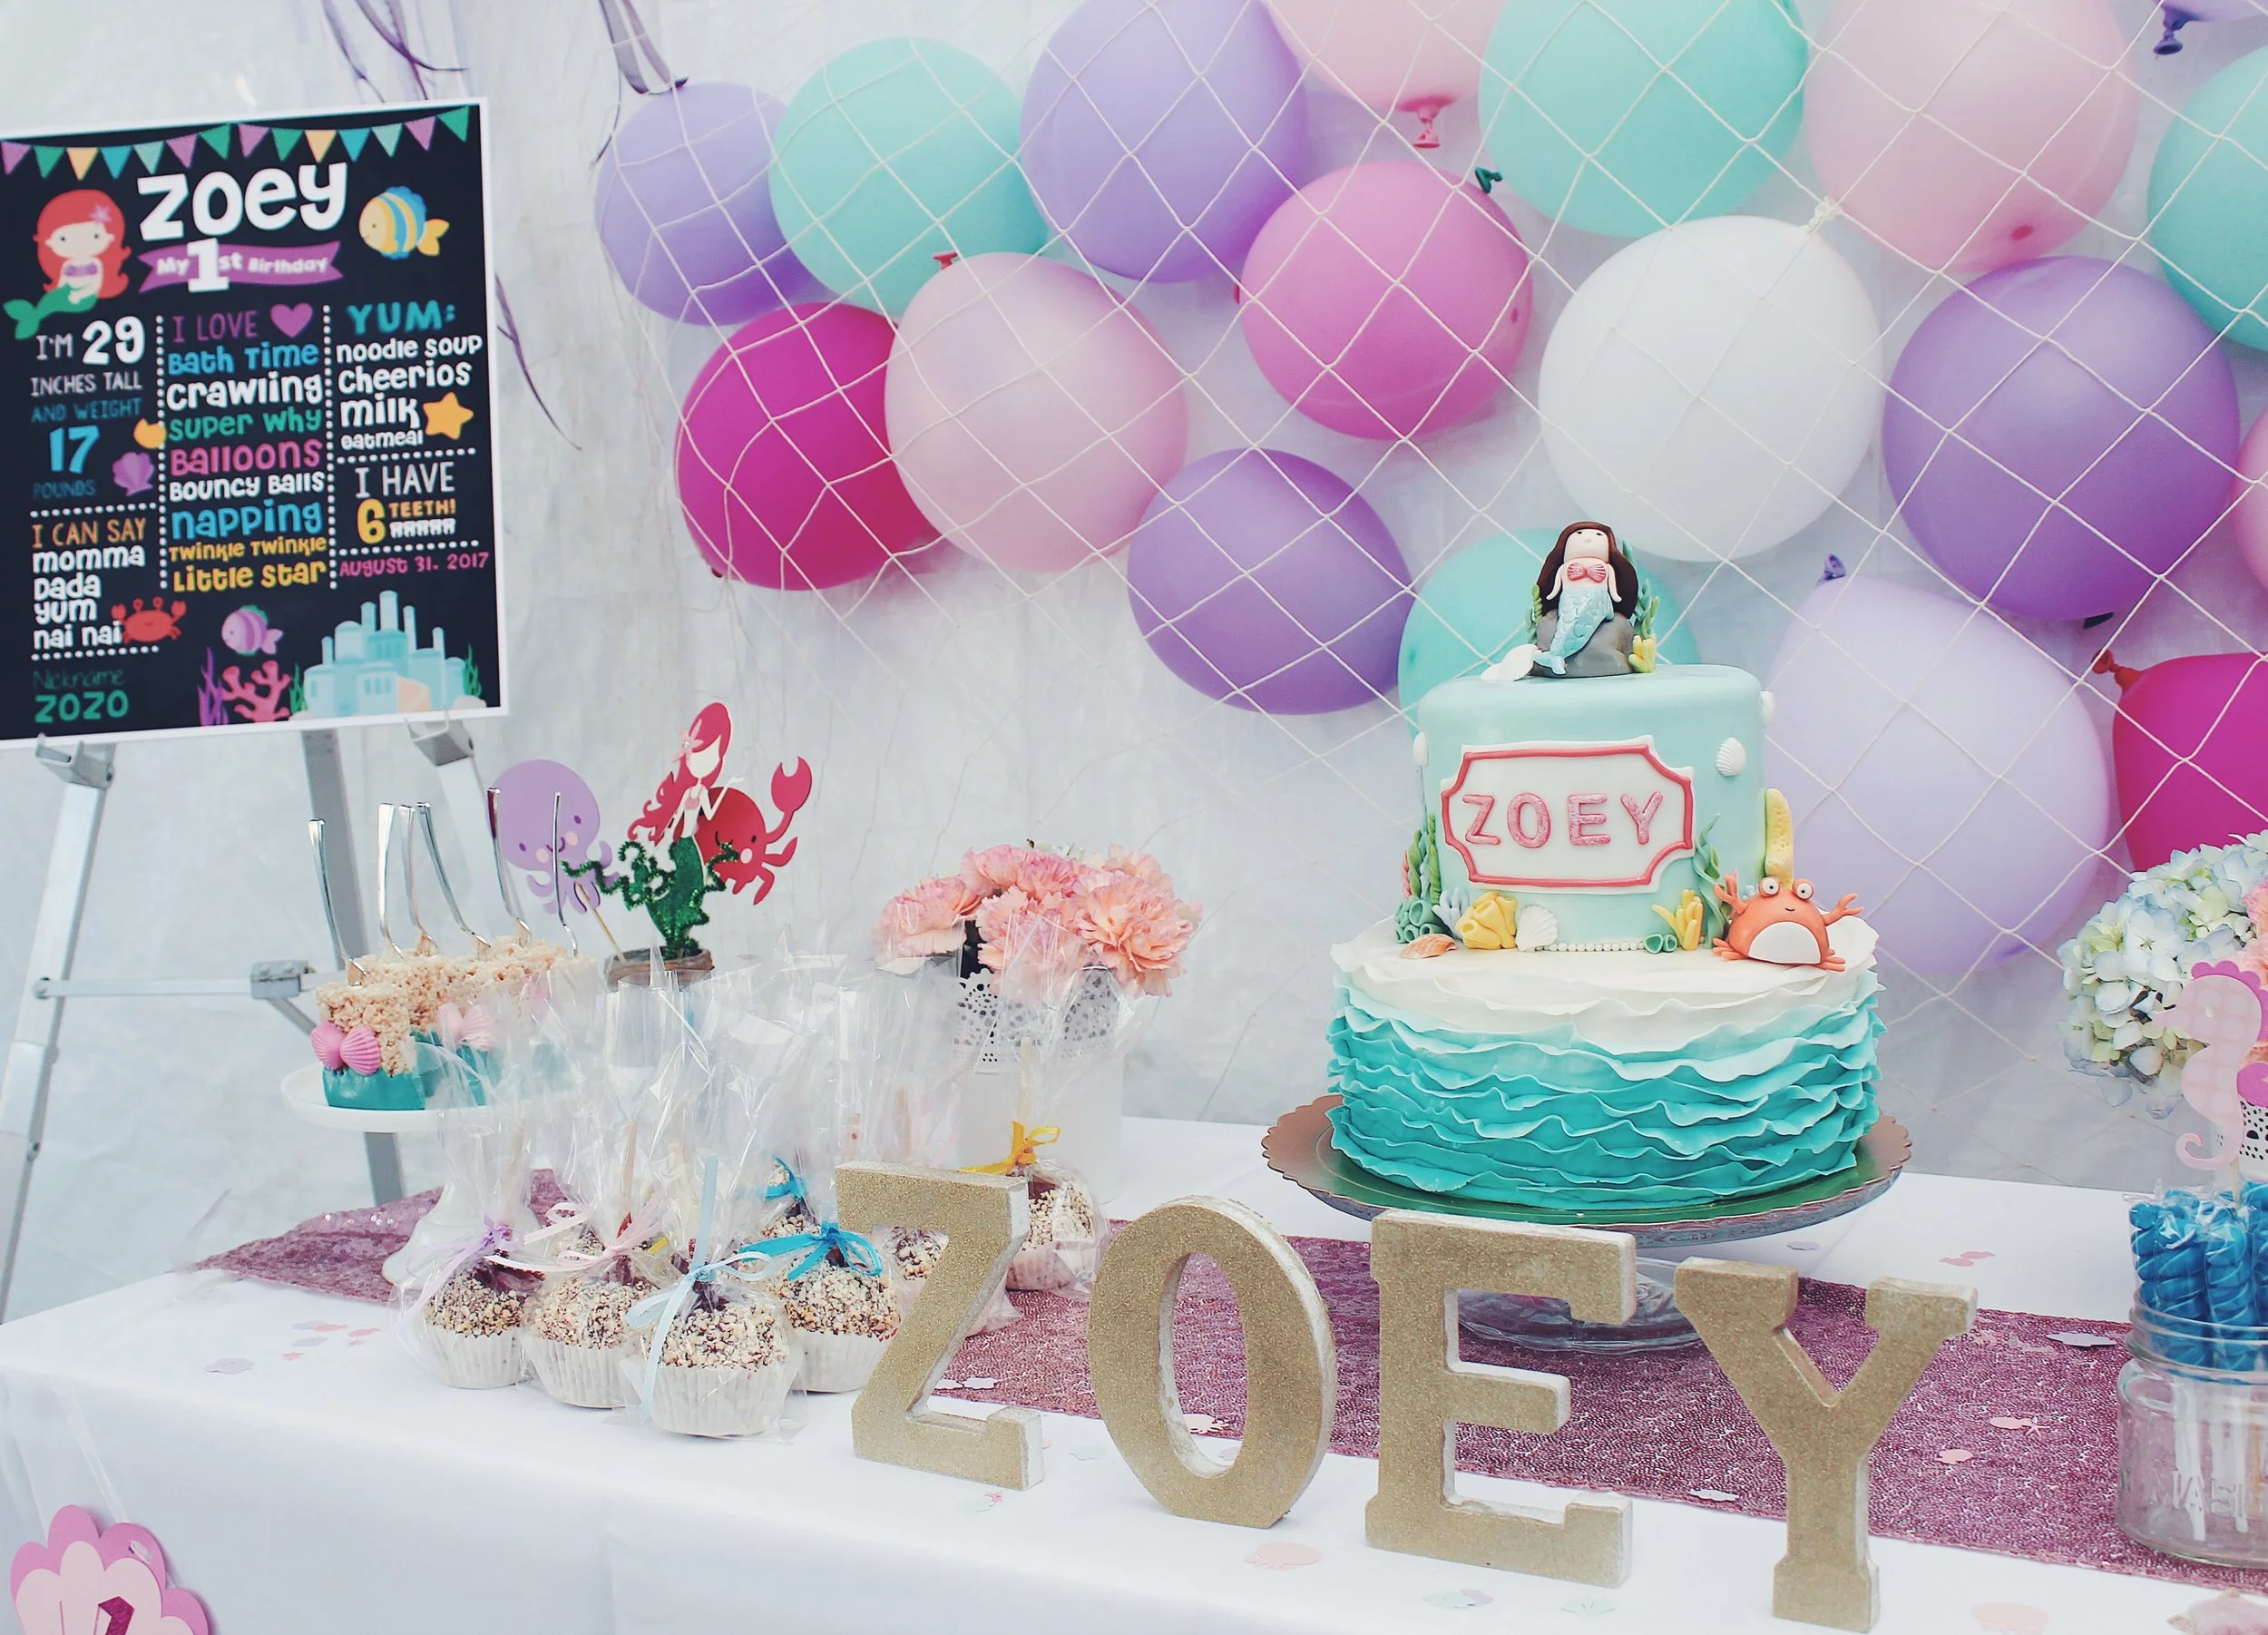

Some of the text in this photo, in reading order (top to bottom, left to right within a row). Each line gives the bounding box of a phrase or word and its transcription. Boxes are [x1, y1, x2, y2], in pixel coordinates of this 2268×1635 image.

[157, 257, 190, 275] My
[249, 257, 328, 273] Birthday
[172, 309, 258, 343] I LOVE
[347, 299, 455, 335] YUM:
[35, 316, 145, 366] I'M 29
[336, 334, 483, 364] noodle soup
[168, 341, 319, 376] Bath Time
[31, 370, 143, 397] INCHES TALL
[166, 370, 324, 411] crawling
[337, 359, 473, 395] cheerios
[31, 397, 142, 423] AND WEIGHT
[262, 406, 321, 433] why
[340, 392, 421, 429] milk
[50, 425, 100, 475] 17
[170, 438, 324, 476] Balloons
[33, 480, 96, 499] POUNDS
[169, 471, 326, 502] Bouncy Balls
[355, 461, 455, 498] I HAVE
[32, 517, 146, 548] I CAN SAY
[171, 498, 323, 540] napping
[357, 498, 456, 545] 6 TEETH!
[33, 544, 146, 573] momma
[169, 535, 327, 563] Twinkle Twinkle
[446, 551, 489, 571] 2017
[34, 573, 102, 602] Dada
[173, 564, 254, 592] Little
[34, 598, 97, 625] yum
[34, 620, 122, 651] nai nai
[34, 668, 125, 690] Nickname
[1461, 790, 1664, 849] ZOEY
[836, 1160, 1976, 1634] ZOEY
